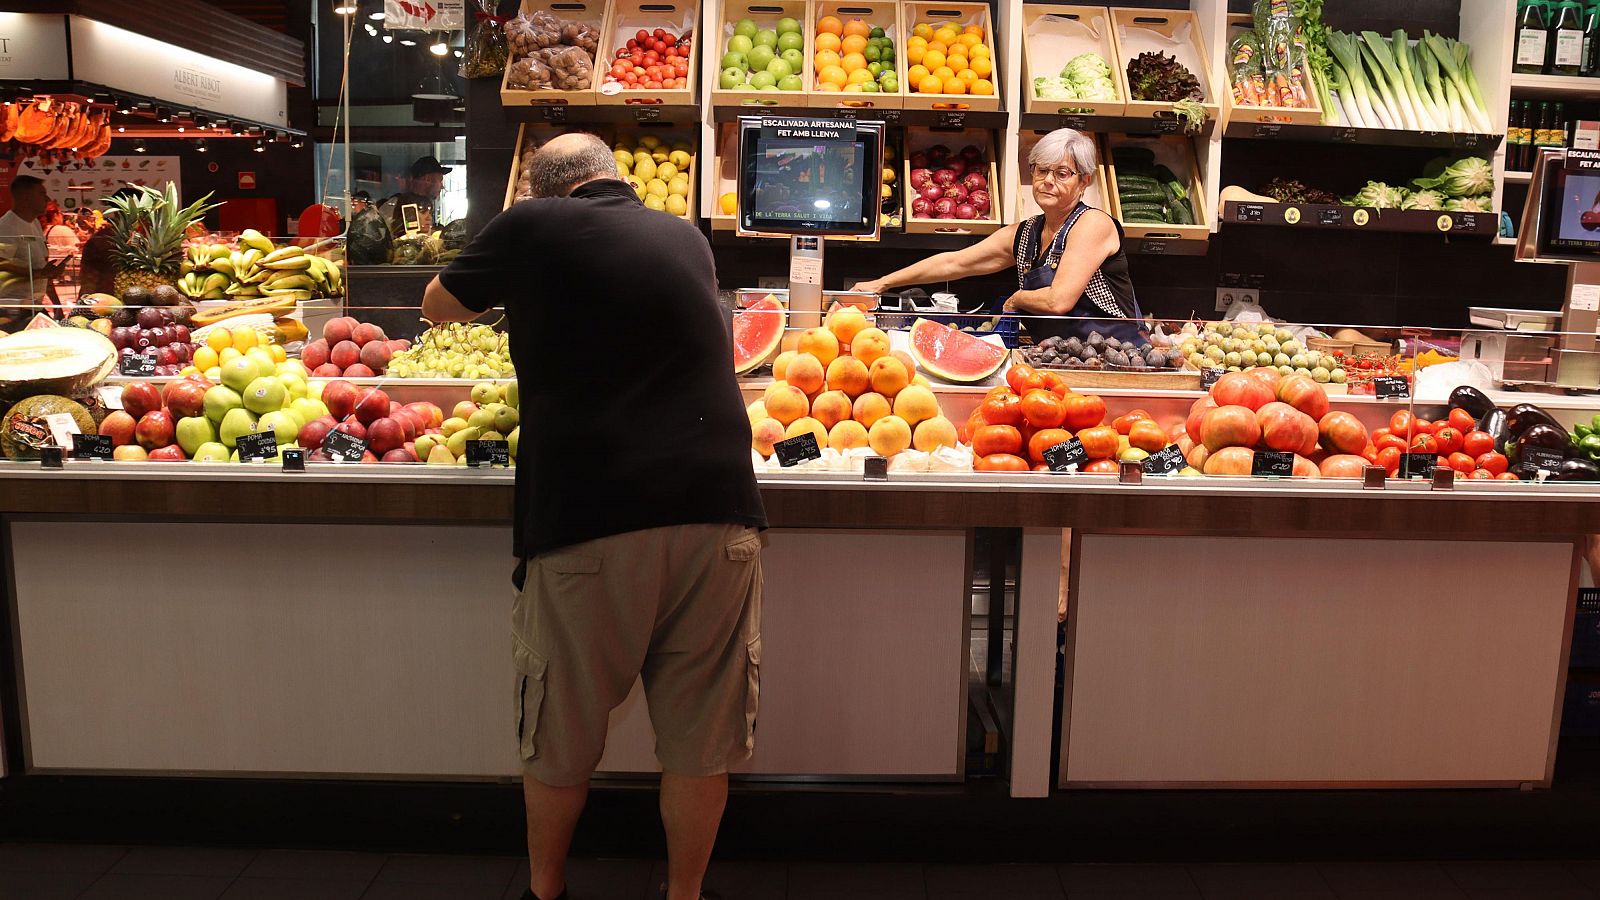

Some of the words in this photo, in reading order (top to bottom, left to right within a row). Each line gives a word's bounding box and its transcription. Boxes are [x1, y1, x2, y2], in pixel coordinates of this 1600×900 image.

[174, 70, 199, 87] ALBERT
[200, 76, 221, 93] RIBOT
[762, 119, 810, 128] ESCALIVADA
[810, 120, 855, 130] ARTESANAL
[777, 129, 792, 138] FET
[793, 130, 811, 138] AMB
[811, 130, 840, 139] LLENYA
[1568, 150, 1600, 160] ESCALIVA
[1580, 160, 1593, 168] FET
[84, 433, 100, 441] POMA
[247, 433, 263, 442] POMA
[259, 445, 277, 454] 3'95
